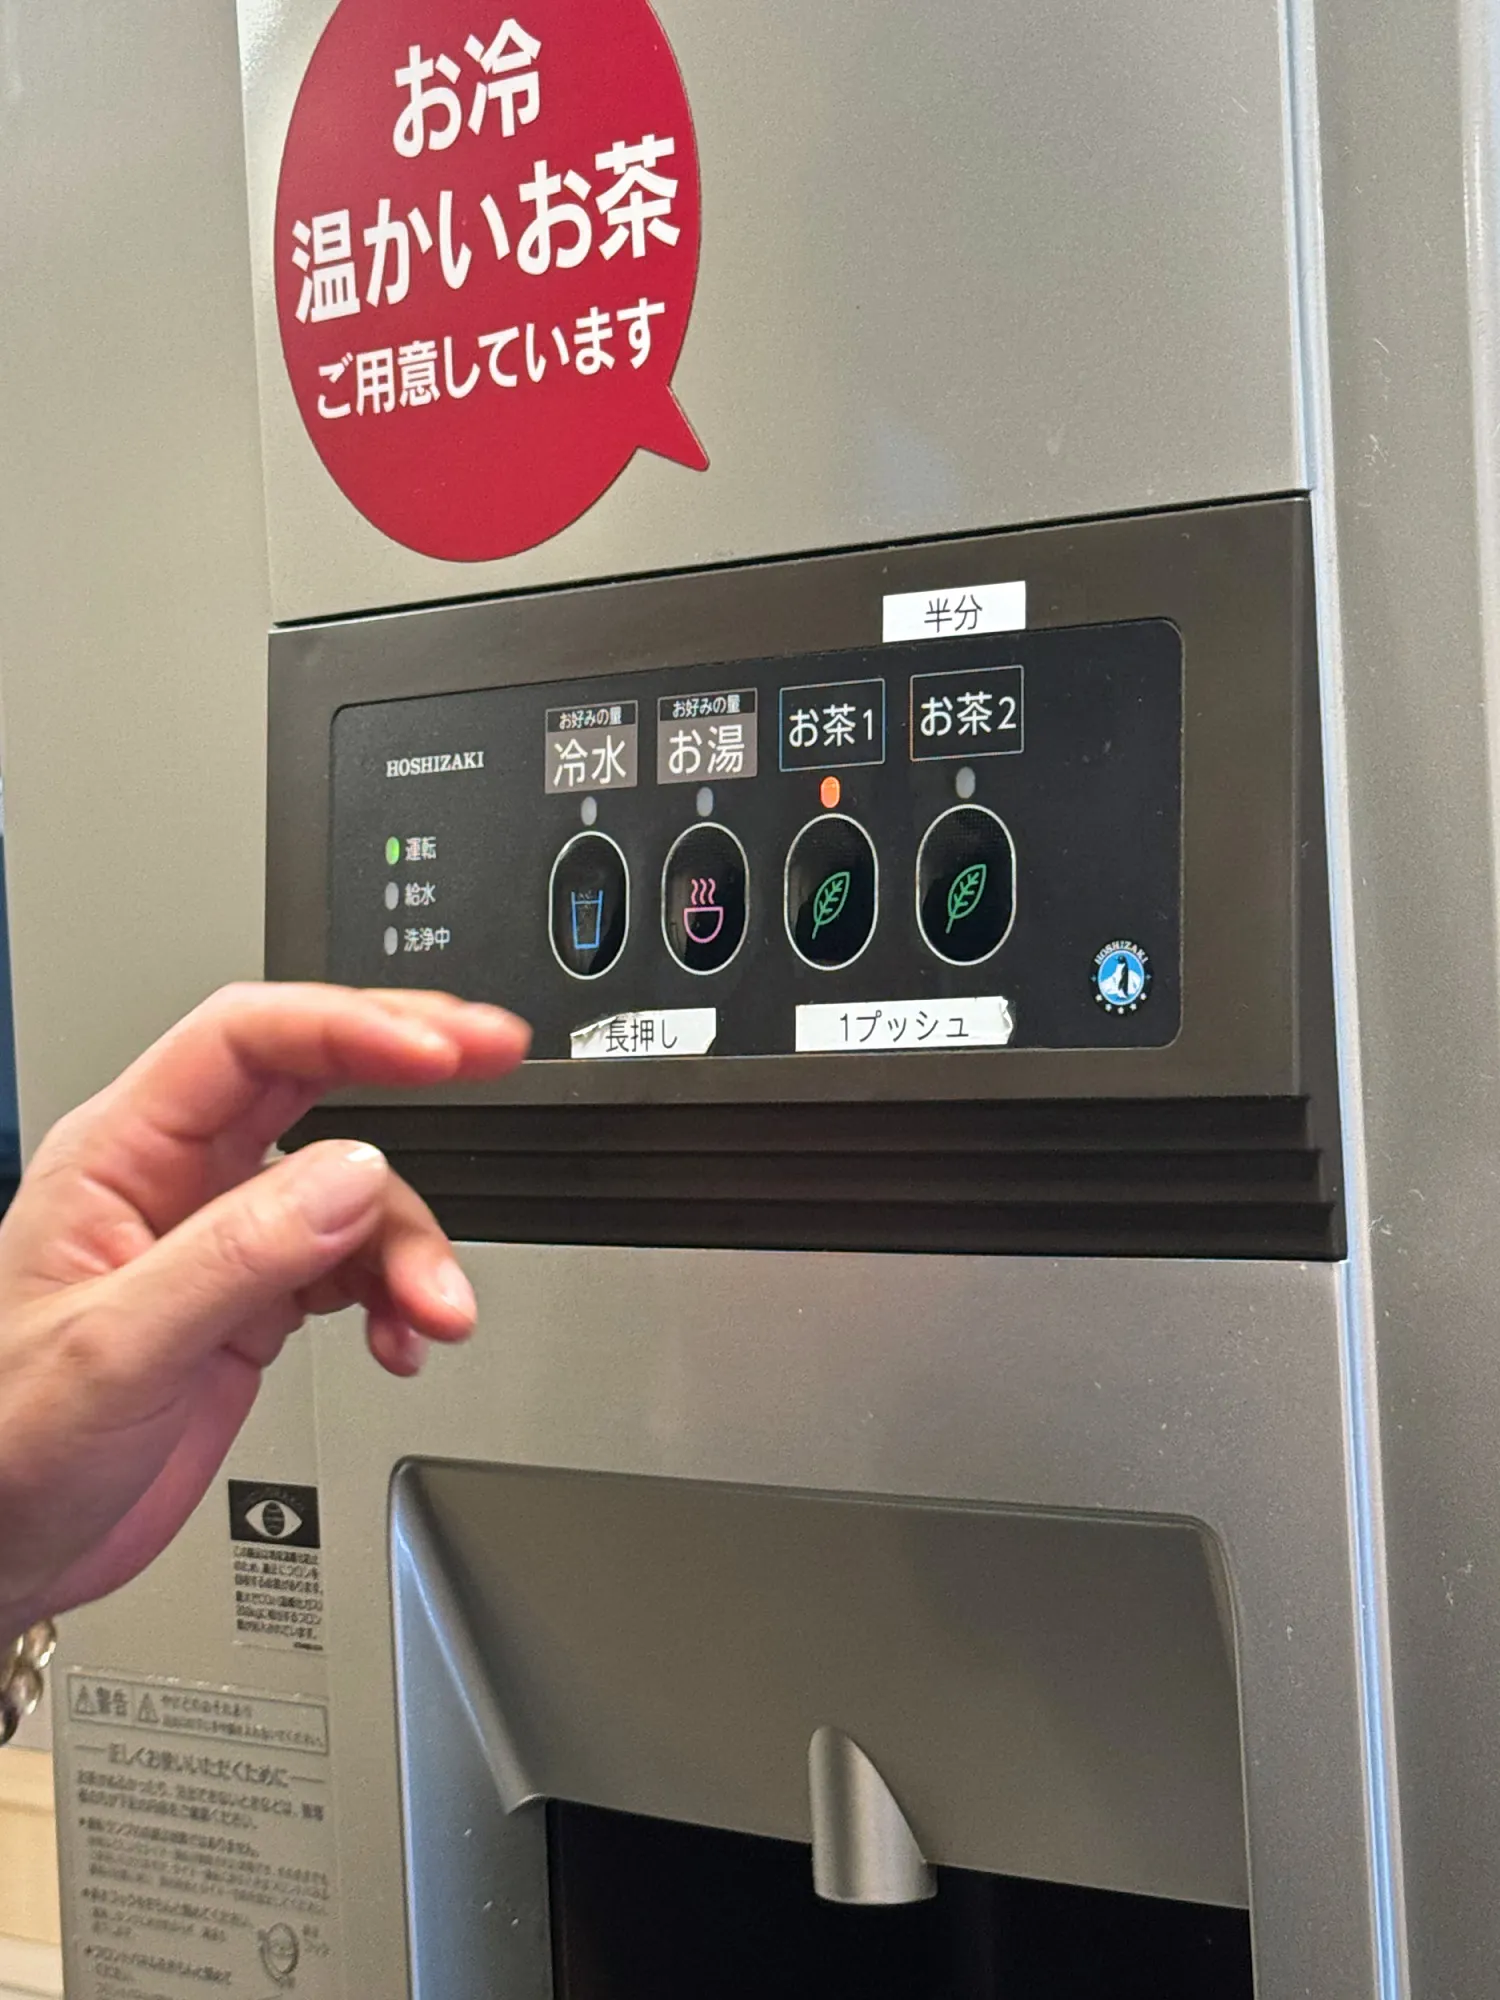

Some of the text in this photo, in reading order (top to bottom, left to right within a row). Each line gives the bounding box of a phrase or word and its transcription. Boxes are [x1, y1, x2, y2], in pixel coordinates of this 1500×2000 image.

[392, 18, 541, 158] お冷
[291, 134, 681, 324] 温かいお茶
[317, 297, 666, 420] ご用意しています
[923, 594, 983, 633] 半分
[559, 705, 623, 730] お好みの量
[672, 694, 741, 718] お好みの量
[920, 691, 1018, 738] お茶2
[788, 703, 874, 748] お茶1
[386, 751, 485, 778] HOSHIZAKI
[553, 733, 627, 788] 冷水
[667, 723, 745, 775] お湯
[405, 836, 437, 861] 運転
[404, 881, 437, 907] 給水
[403, 926, 451, 952] 洗浄中
[1094, 940, 1149, 966] HOSHIZAKI
[605, 1019, 678, 1053] 長押し
[839, 1010, 970, 1043] 1プッシュ
